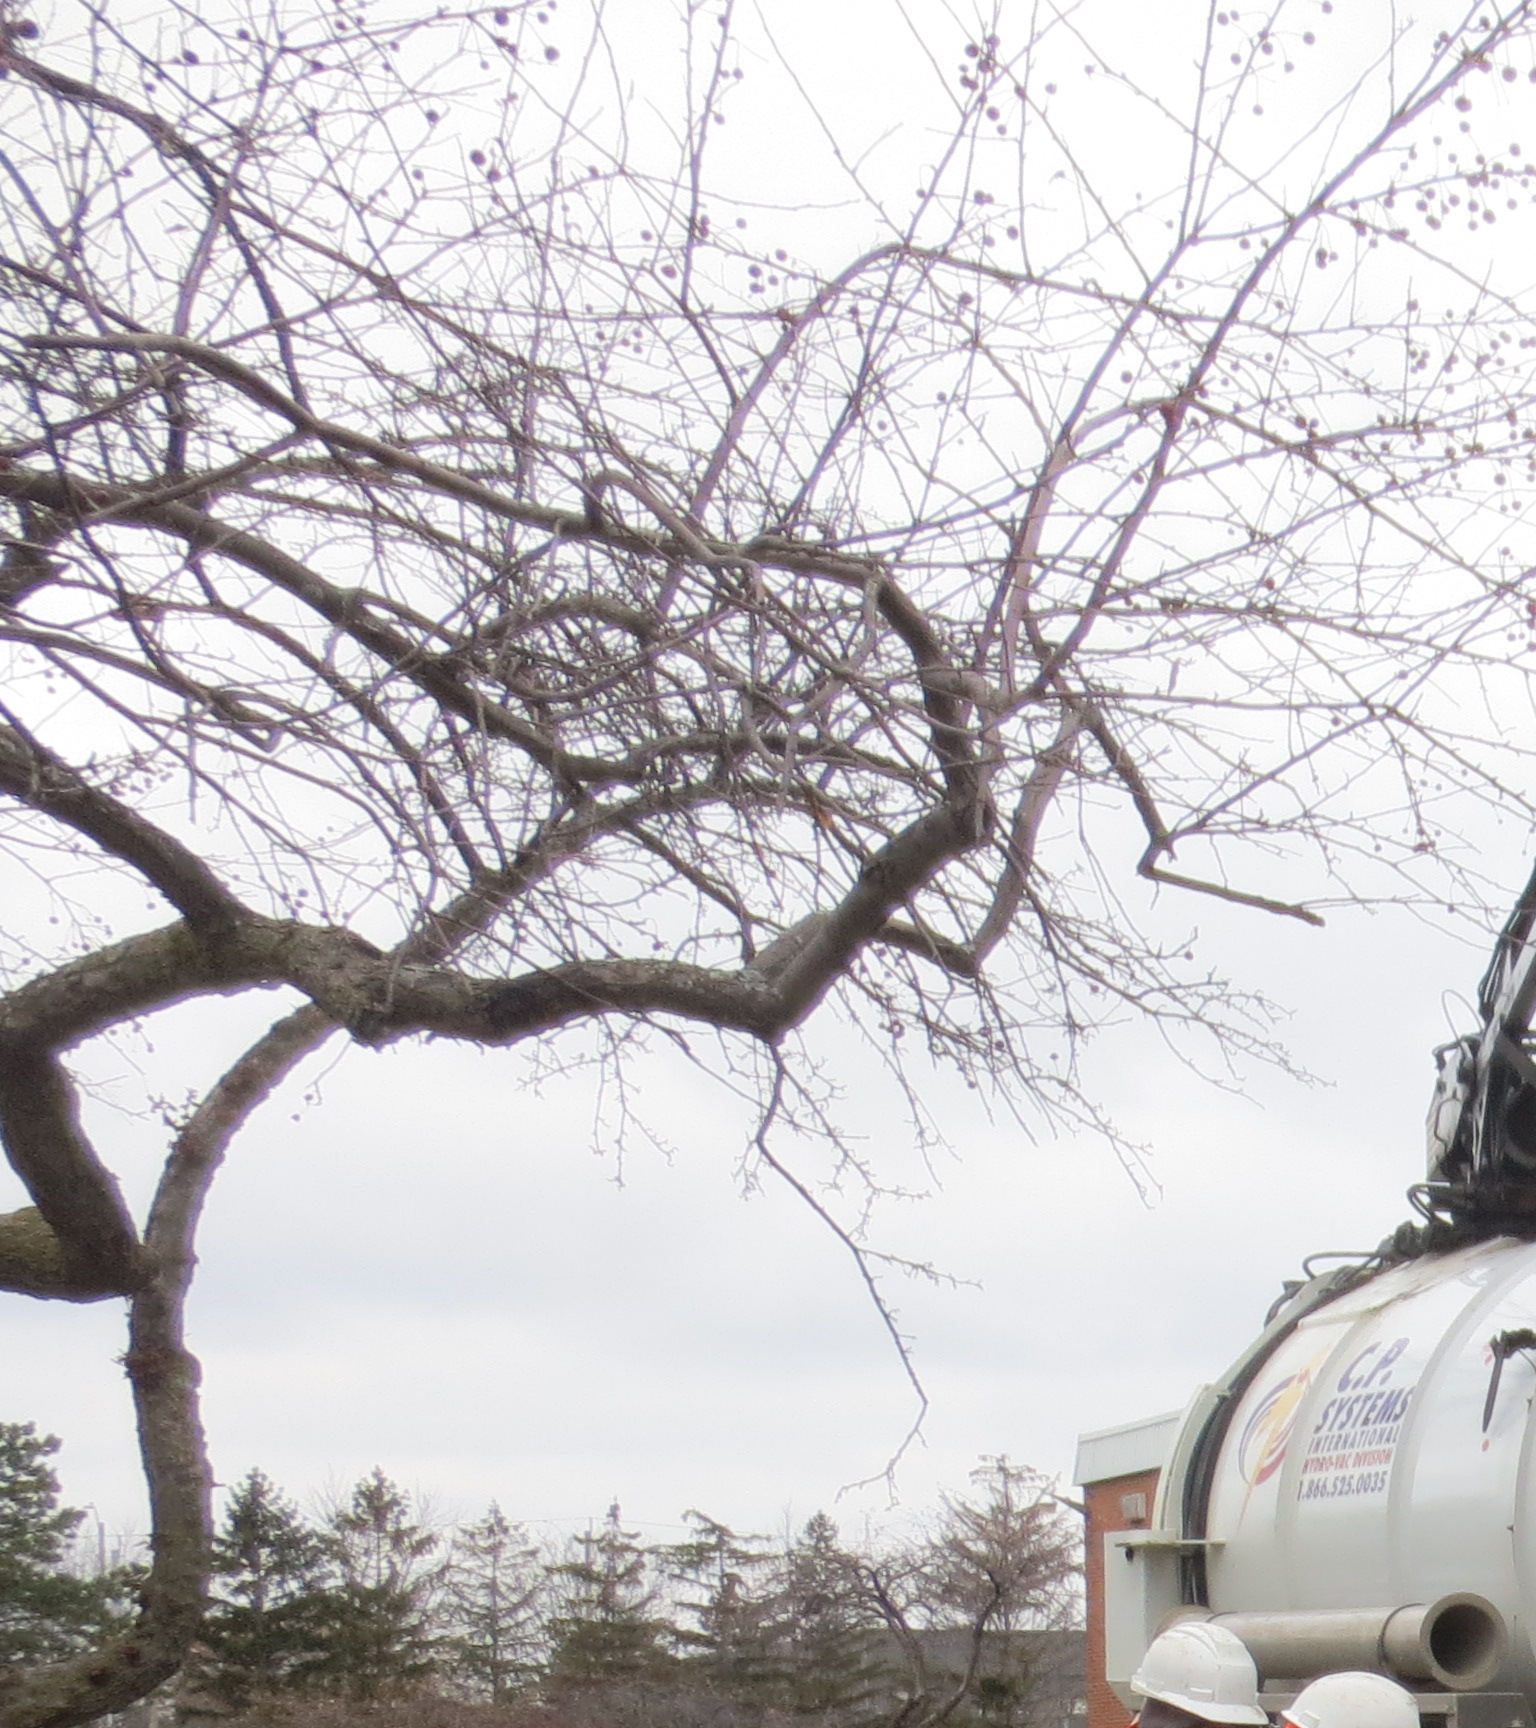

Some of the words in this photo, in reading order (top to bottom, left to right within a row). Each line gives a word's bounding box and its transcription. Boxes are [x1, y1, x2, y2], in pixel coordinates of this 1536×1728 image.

[1337, 1337, 1411, 1394] C.P.
[1313, 1386, 1416, 1435] SYSTEMS
[1307, 1423, 1401, 1456] INTERNATIONAL
[1301, 1452, 1354, 1475] HYDRO-VAC
[1353, 1448, 1395, 1470] DIVISION
[1296, 1470, 1388, 1502] 1.866.525.0035
